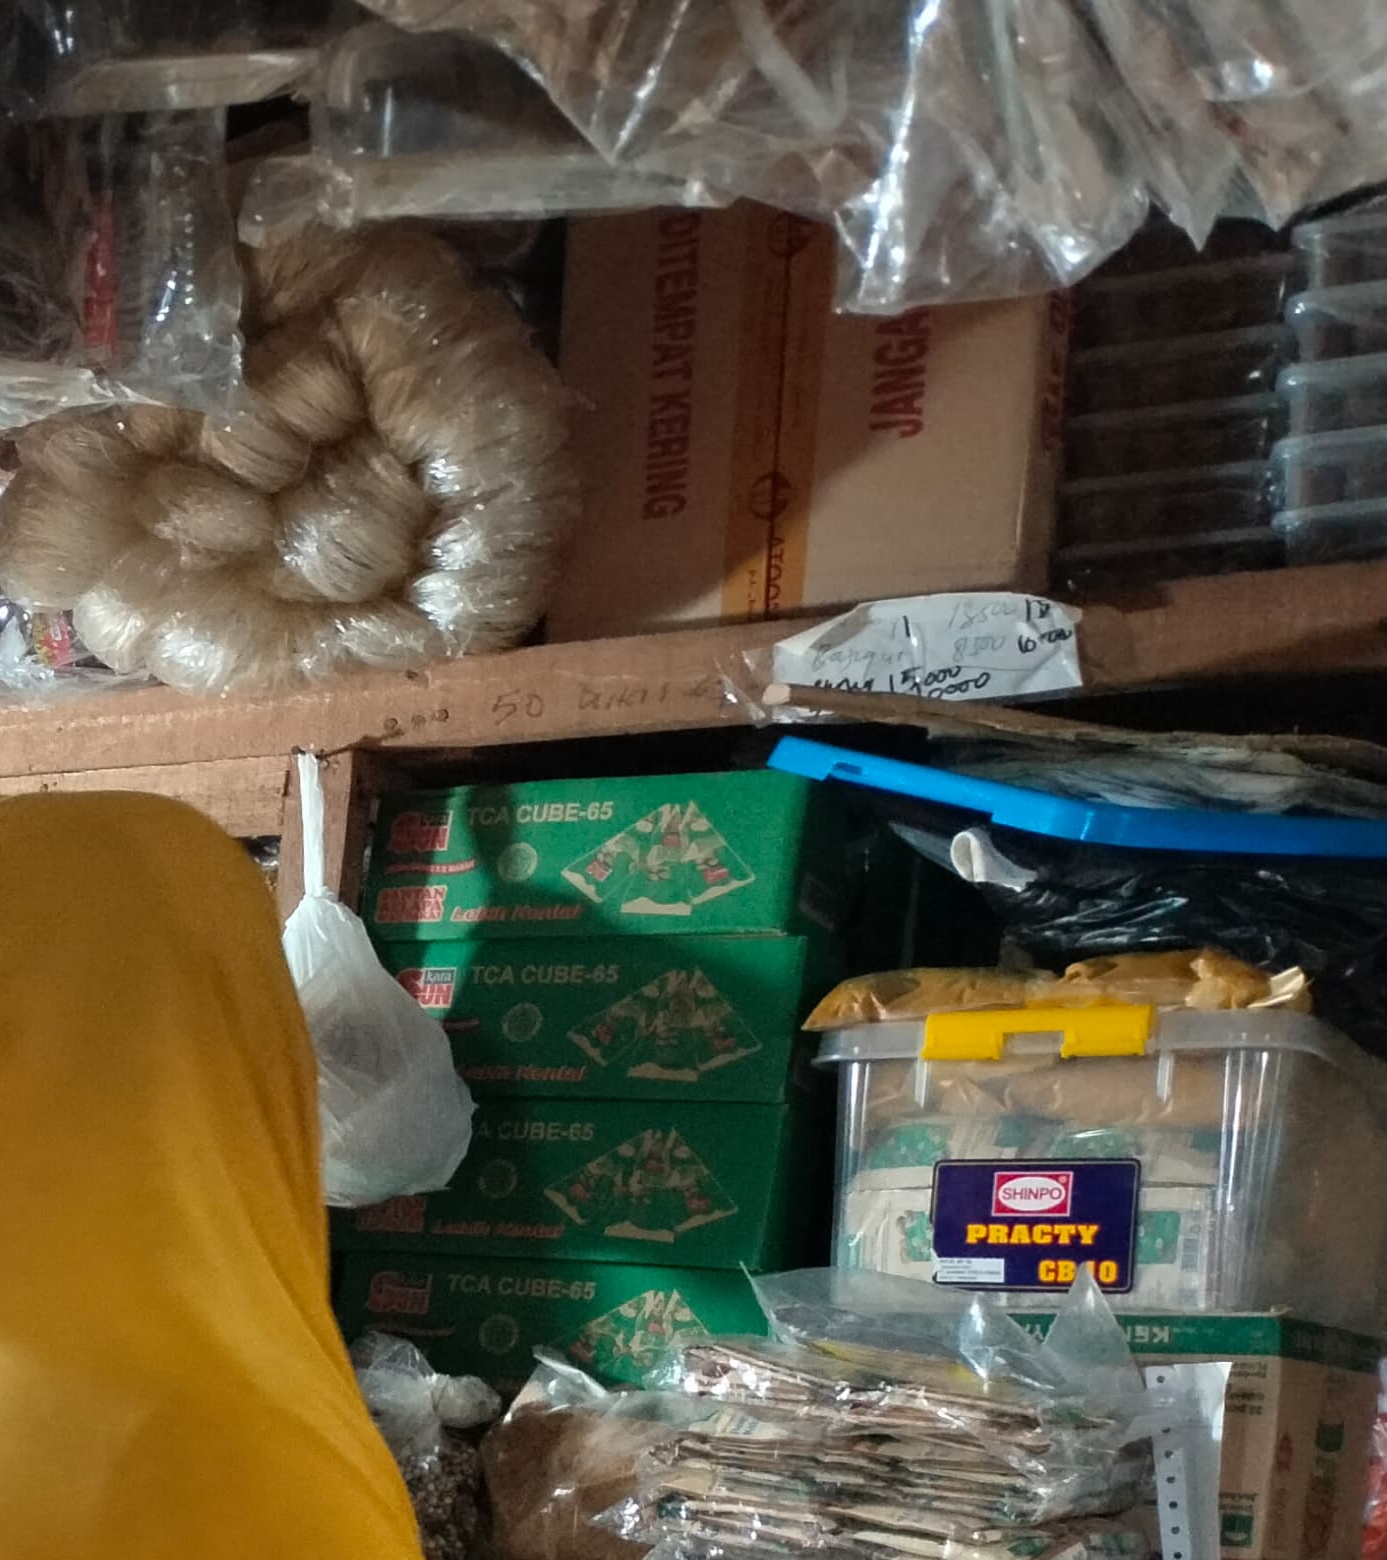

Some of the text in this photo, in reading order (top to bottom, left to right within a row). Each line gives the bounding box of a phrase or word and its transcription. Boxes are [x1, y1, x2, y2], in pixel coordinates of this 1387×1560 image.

[869, 304, 931, 439] JANGA
[643, 396, 692, 521] KERING
[467, 801, 614, 825] TCA CUBE-65
[472, 964, 621, 985] TCA CUBE-65
[1001, 1186, 1063, 1201] SHINPO
[965, 1223, 1100, 1246] PRACTY
[445, 1273, 492, 1294] TCA
[498, 1277, 596, 1301] CUBE-65
